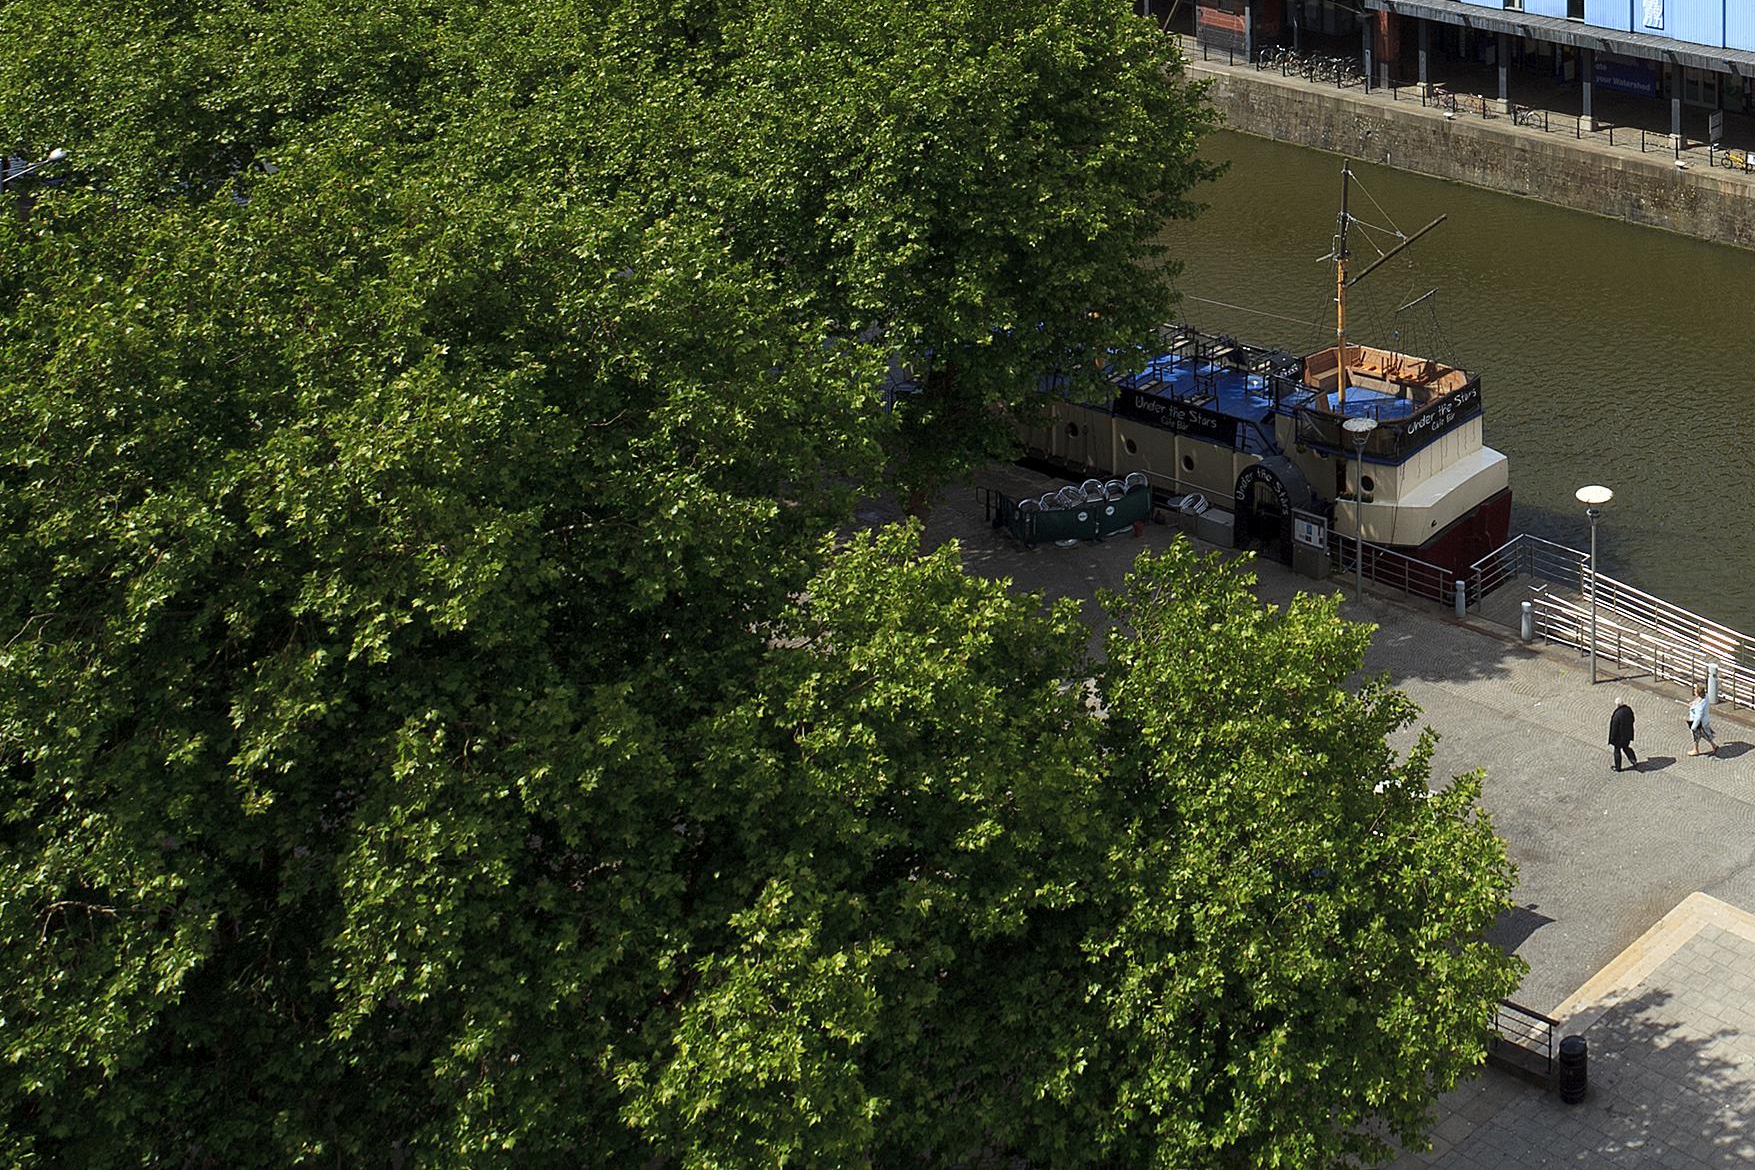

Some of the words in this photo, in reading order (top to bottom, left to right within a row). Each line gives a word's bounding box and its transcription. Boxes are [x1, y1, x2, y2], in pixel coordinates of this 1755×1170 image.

[1135, 396, 1165, 413] Under
[1169, 405, 1186, 420] the
[1189, 410, 1217, 428] Stars
[1177, 420, 1189, 430] Bar
[1407, 412, 1436, 435] Under
[1438, 402, 1453, 416] the
[1454, 388, 1477, 407] Stars
[1236, 471, 1254, 501] Under
[1256, 467, 1272, 482] the
[1274, 481, 1289, 516] Stars
